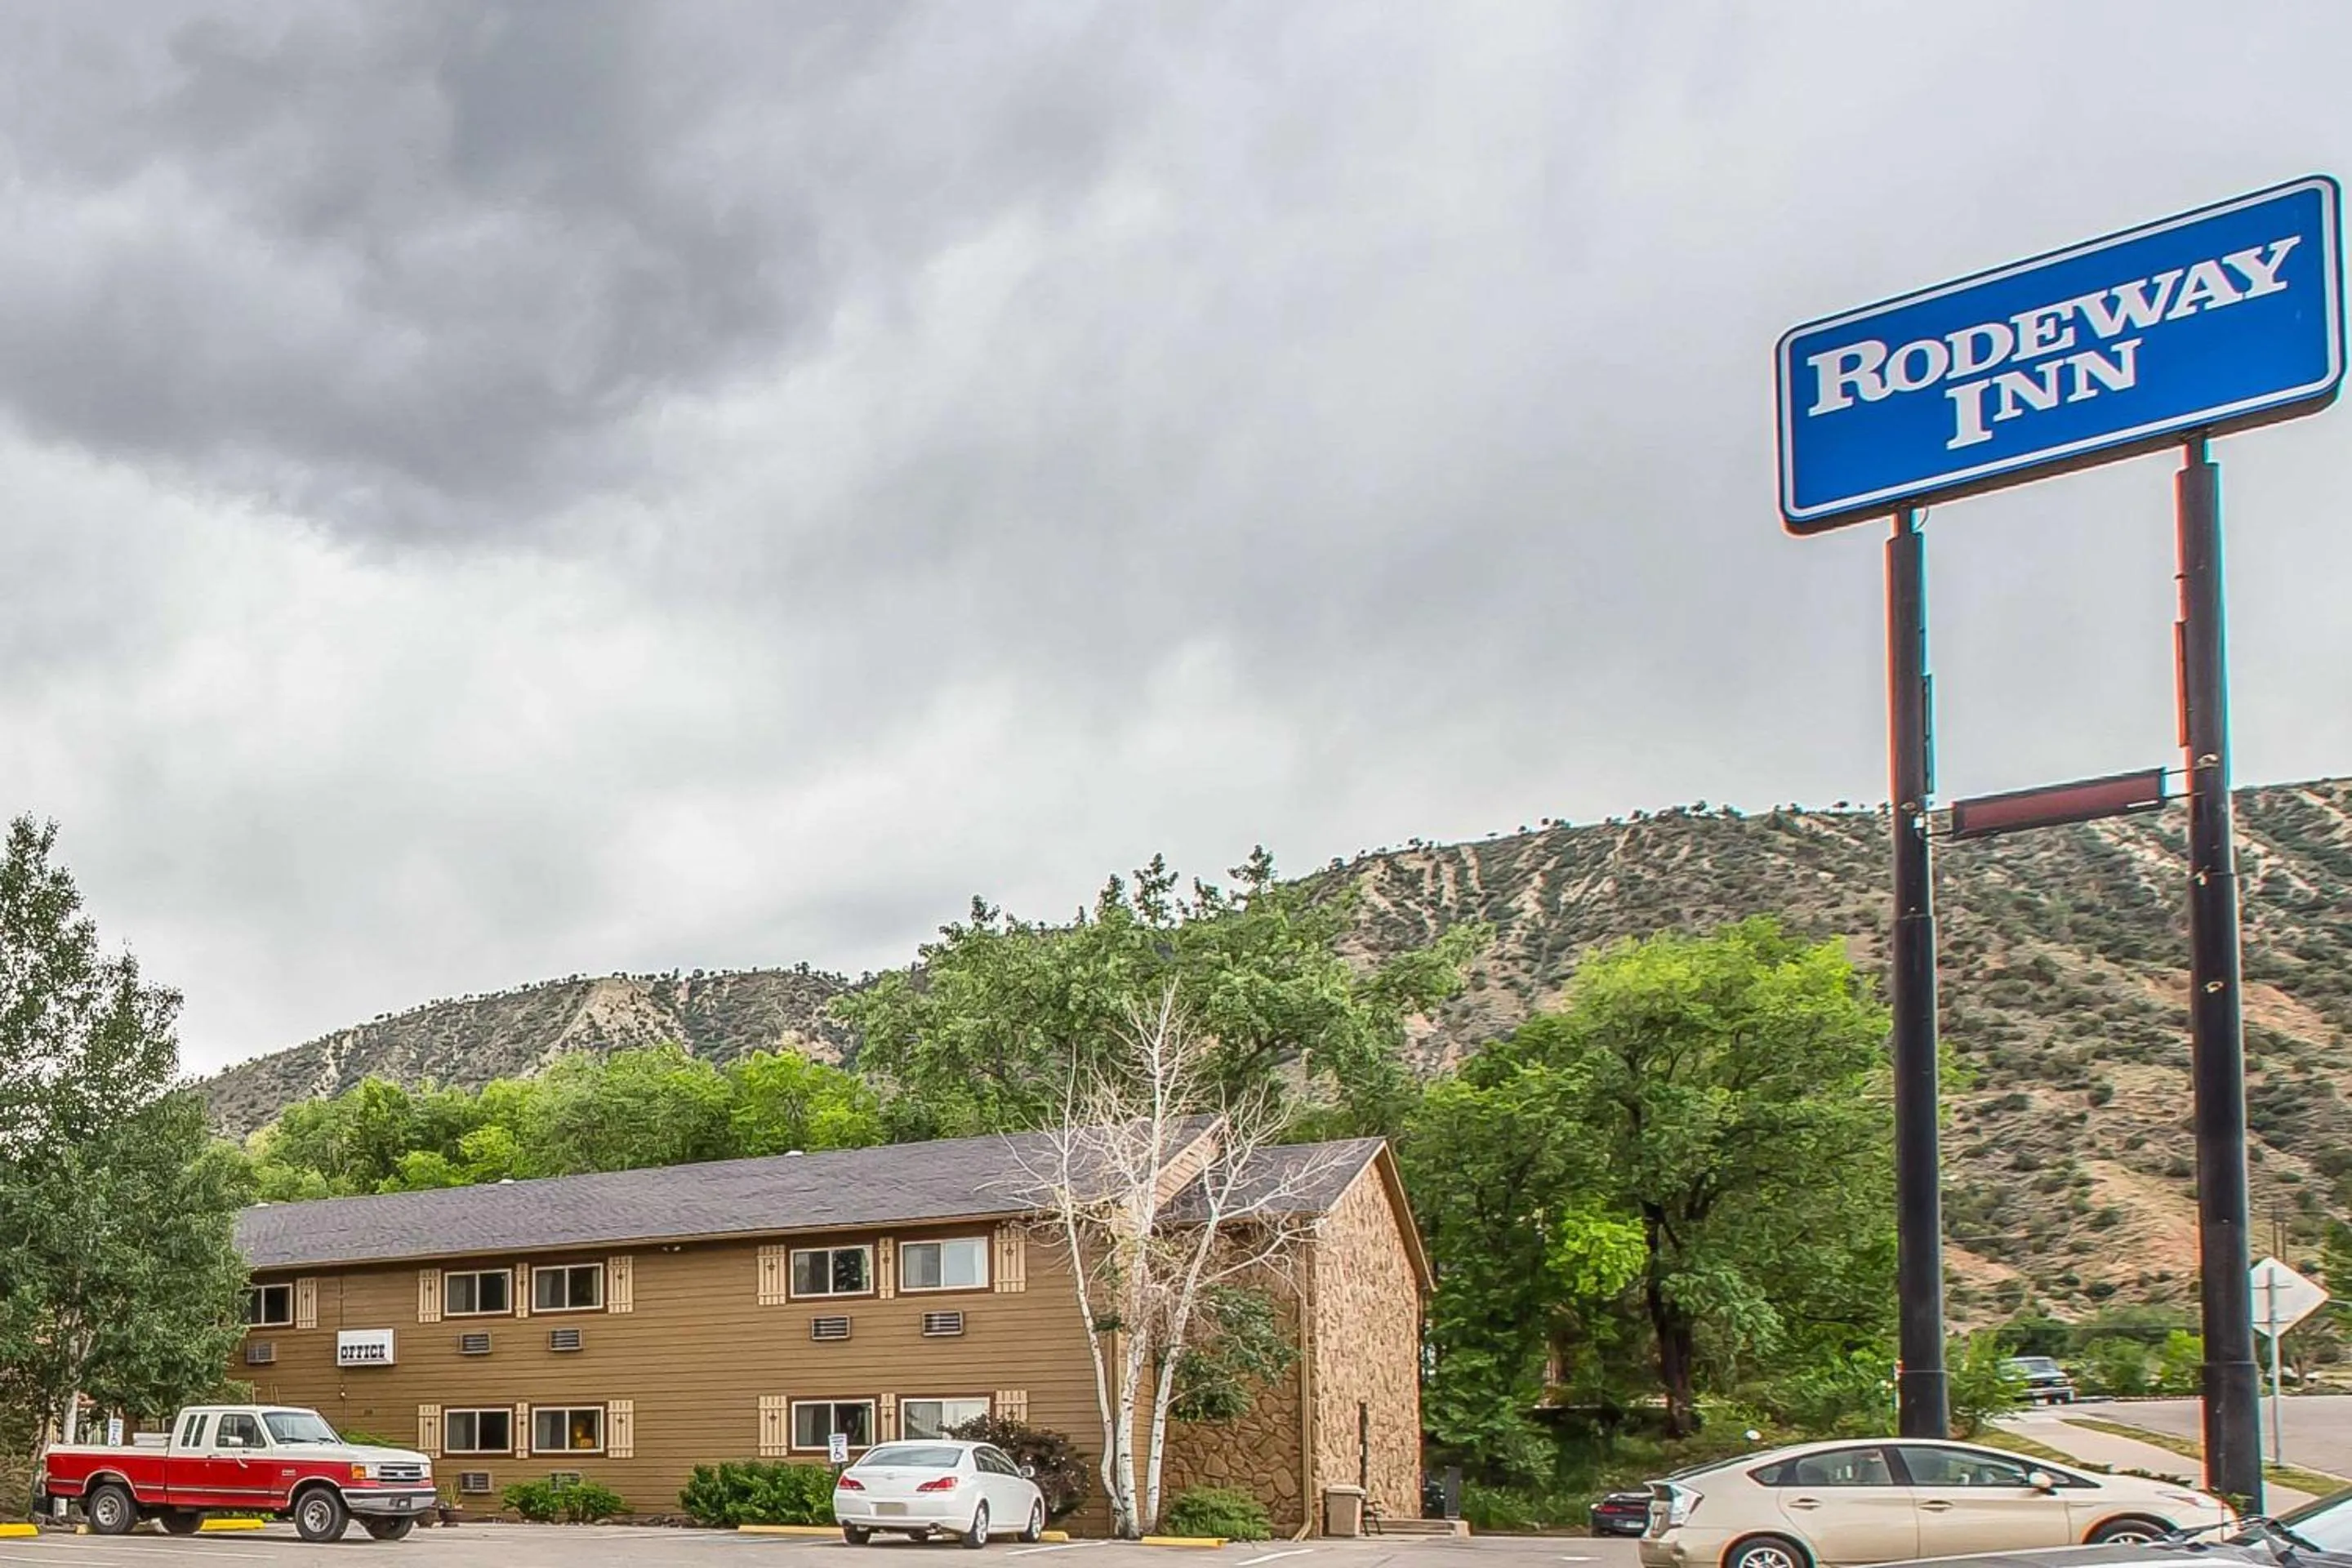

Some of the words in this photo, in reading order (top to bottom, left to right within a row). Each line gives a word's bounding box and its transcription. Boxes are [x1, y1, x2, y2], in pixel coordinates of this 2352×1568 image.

[1807, 235, 2301, 417] RODEWAY
[1946, 338, 2143, 450] INN
[341, 1344, 385, 1359] OFFICE
